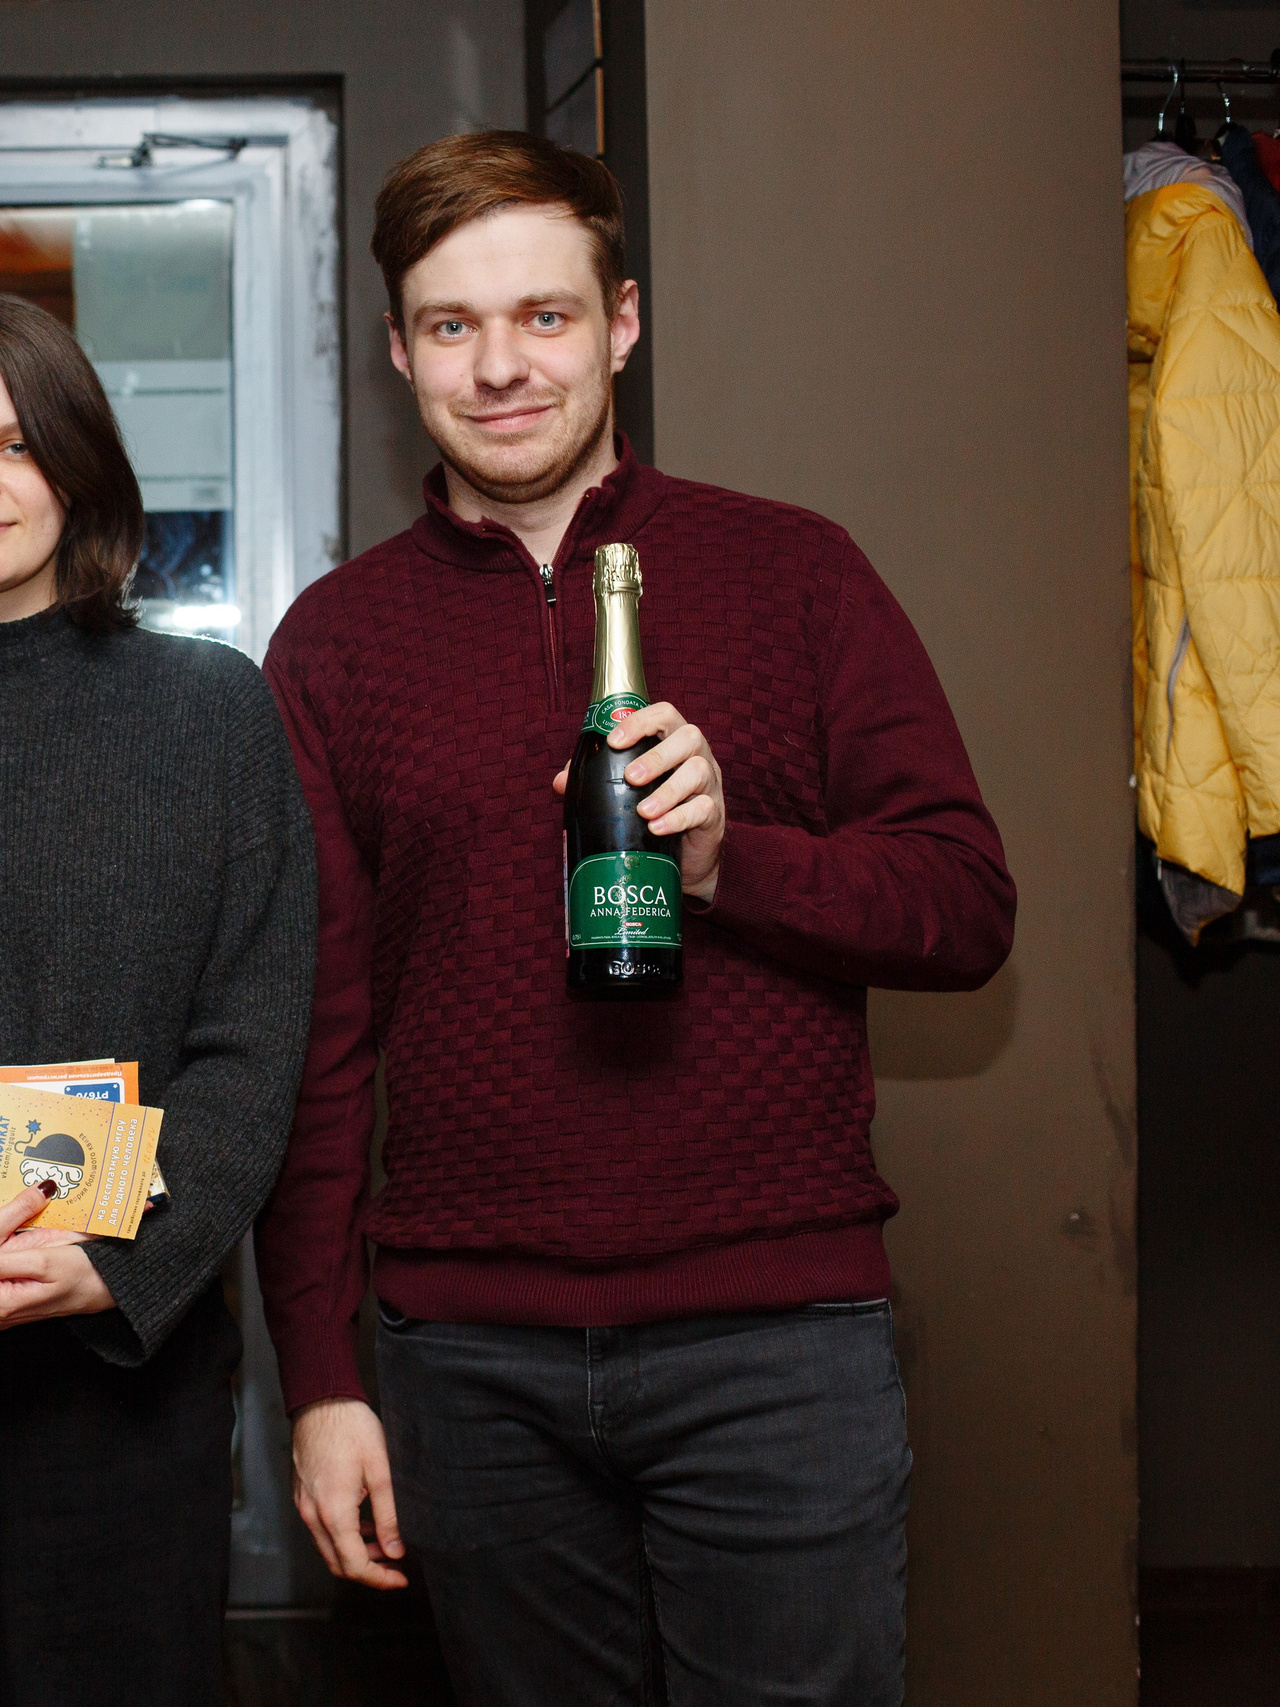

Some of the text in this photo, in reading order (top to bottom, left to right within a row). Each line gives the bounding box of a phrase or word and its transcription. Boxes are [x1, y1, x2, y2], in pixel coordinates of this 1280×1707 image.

[601, 704, 613, 714] CASA
[590, 907, 671, 918] ANNA FEDERICA
[594, 885, 668, 905] BOSCA
[1, 1127, 16, 1178] vk.com/bigquiz
[66, 1132, 97, 1205] теория большого квиза
[97, 1119, 127, 1220] на бесплатную игру
[108, 1118, 138, 1225] для одного человека
